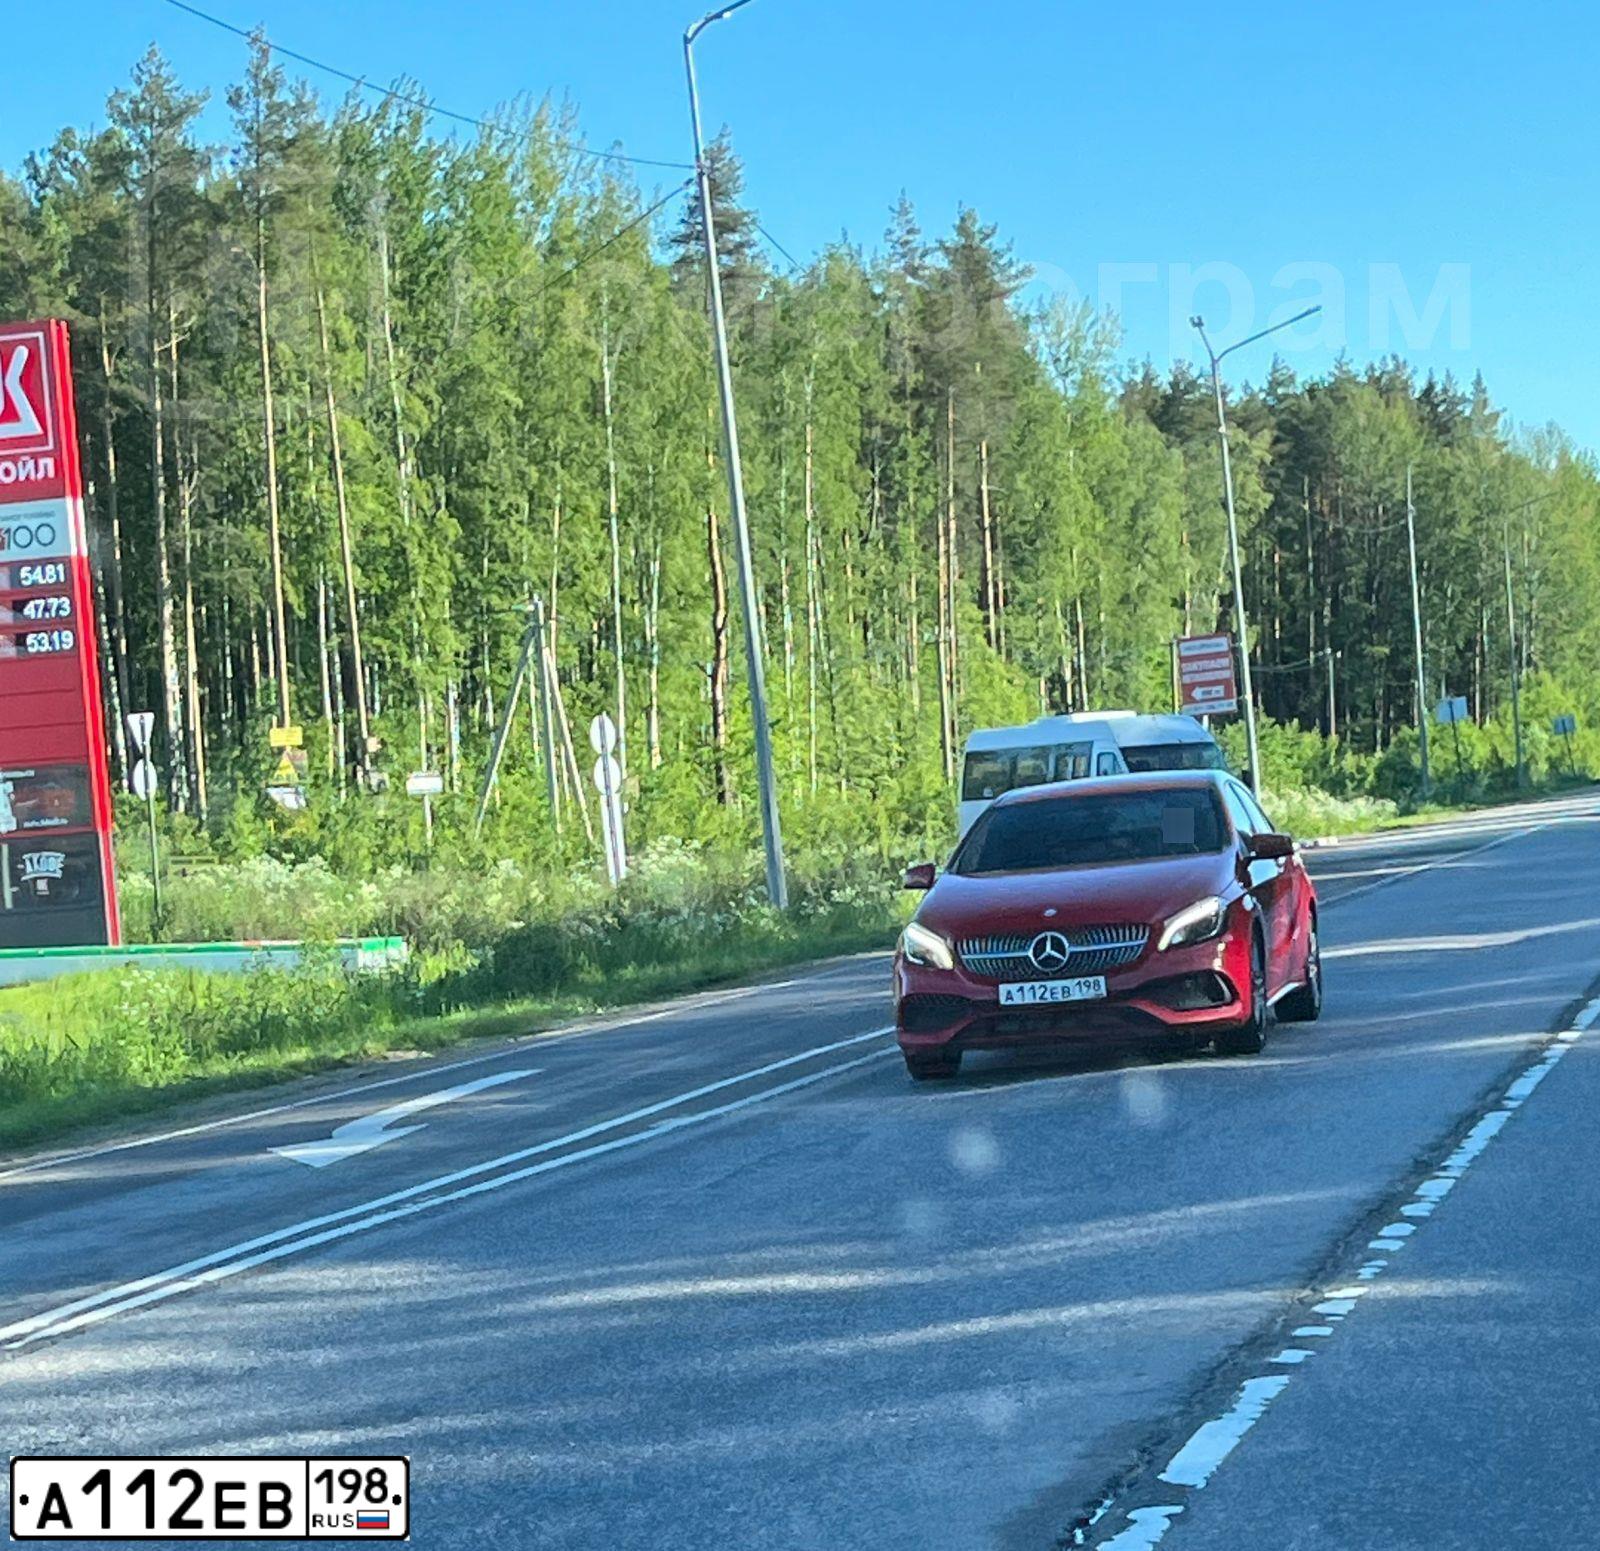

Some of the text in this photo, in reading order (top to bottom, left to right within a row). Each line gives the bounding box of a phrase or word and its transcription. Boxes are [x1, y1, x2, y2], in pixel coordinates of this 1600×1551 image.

[23, 596, 72, 620] 47.73
[26, 630, 74, 653] 53.19
[1075, 979, 1102, 994] 198
